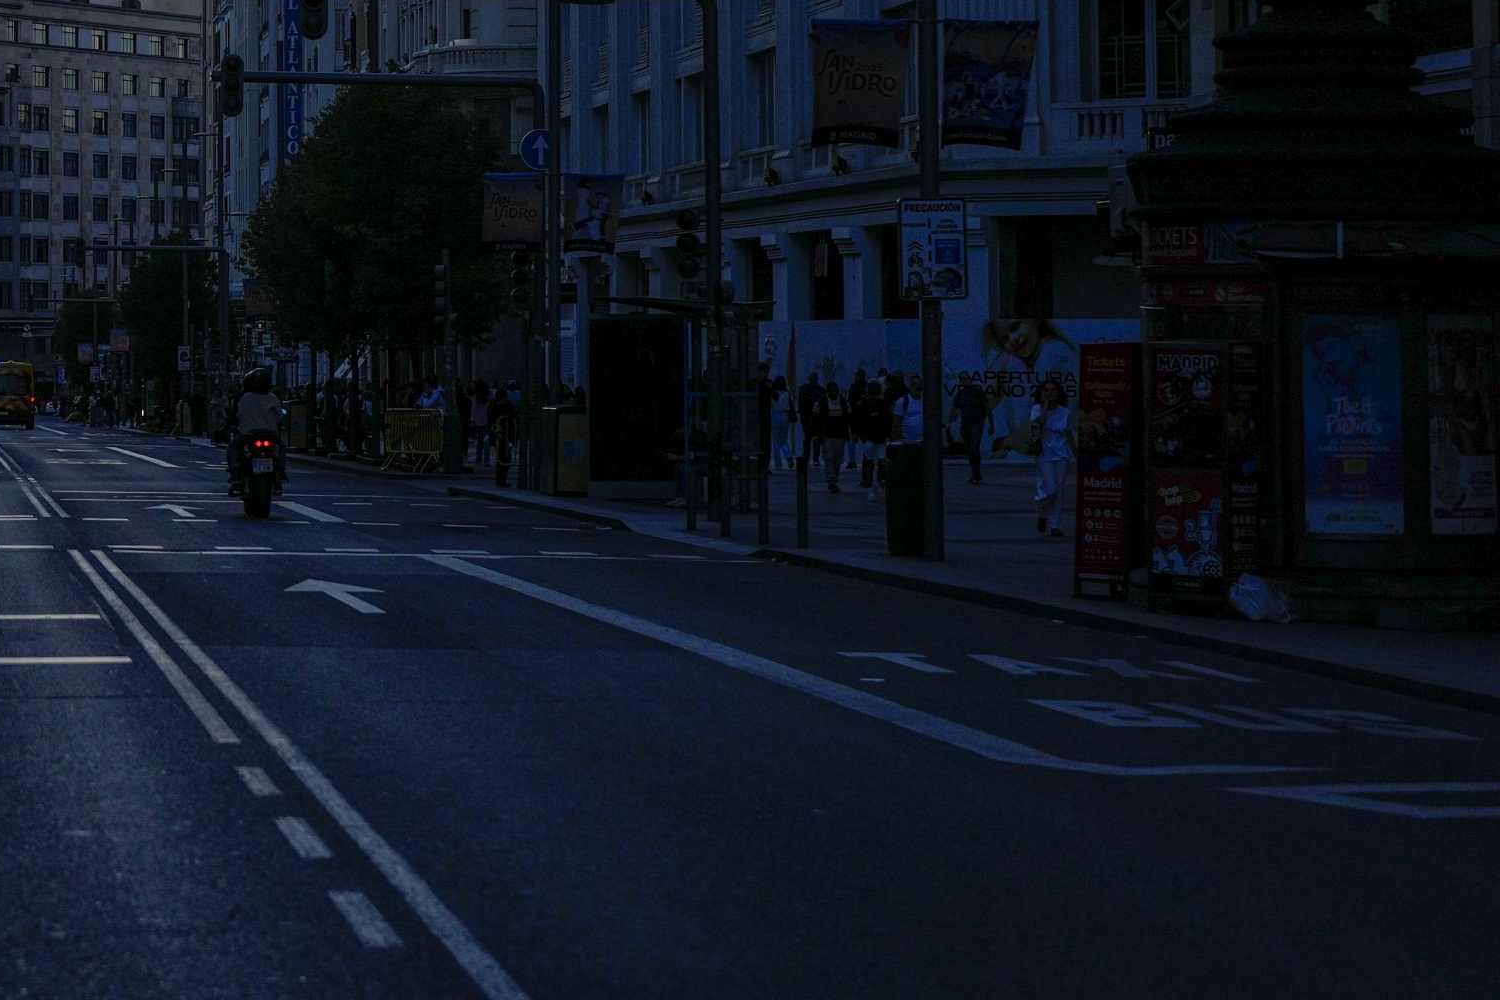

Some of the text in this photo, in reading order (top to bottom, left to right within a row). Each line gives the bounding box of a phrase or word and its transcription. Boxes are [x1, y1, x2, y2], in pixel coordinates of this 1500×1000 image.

[1150, 226, 1198, 246] ICKETS
[1156, 353, 1220, 371] MADRID
[971, 370, 1078, 384] APERTURA
[1030, 384, 1077, 398] 25
[1084, 476, 1123, 489] Madrid
[835, 652, 1268, 684] TAXI
